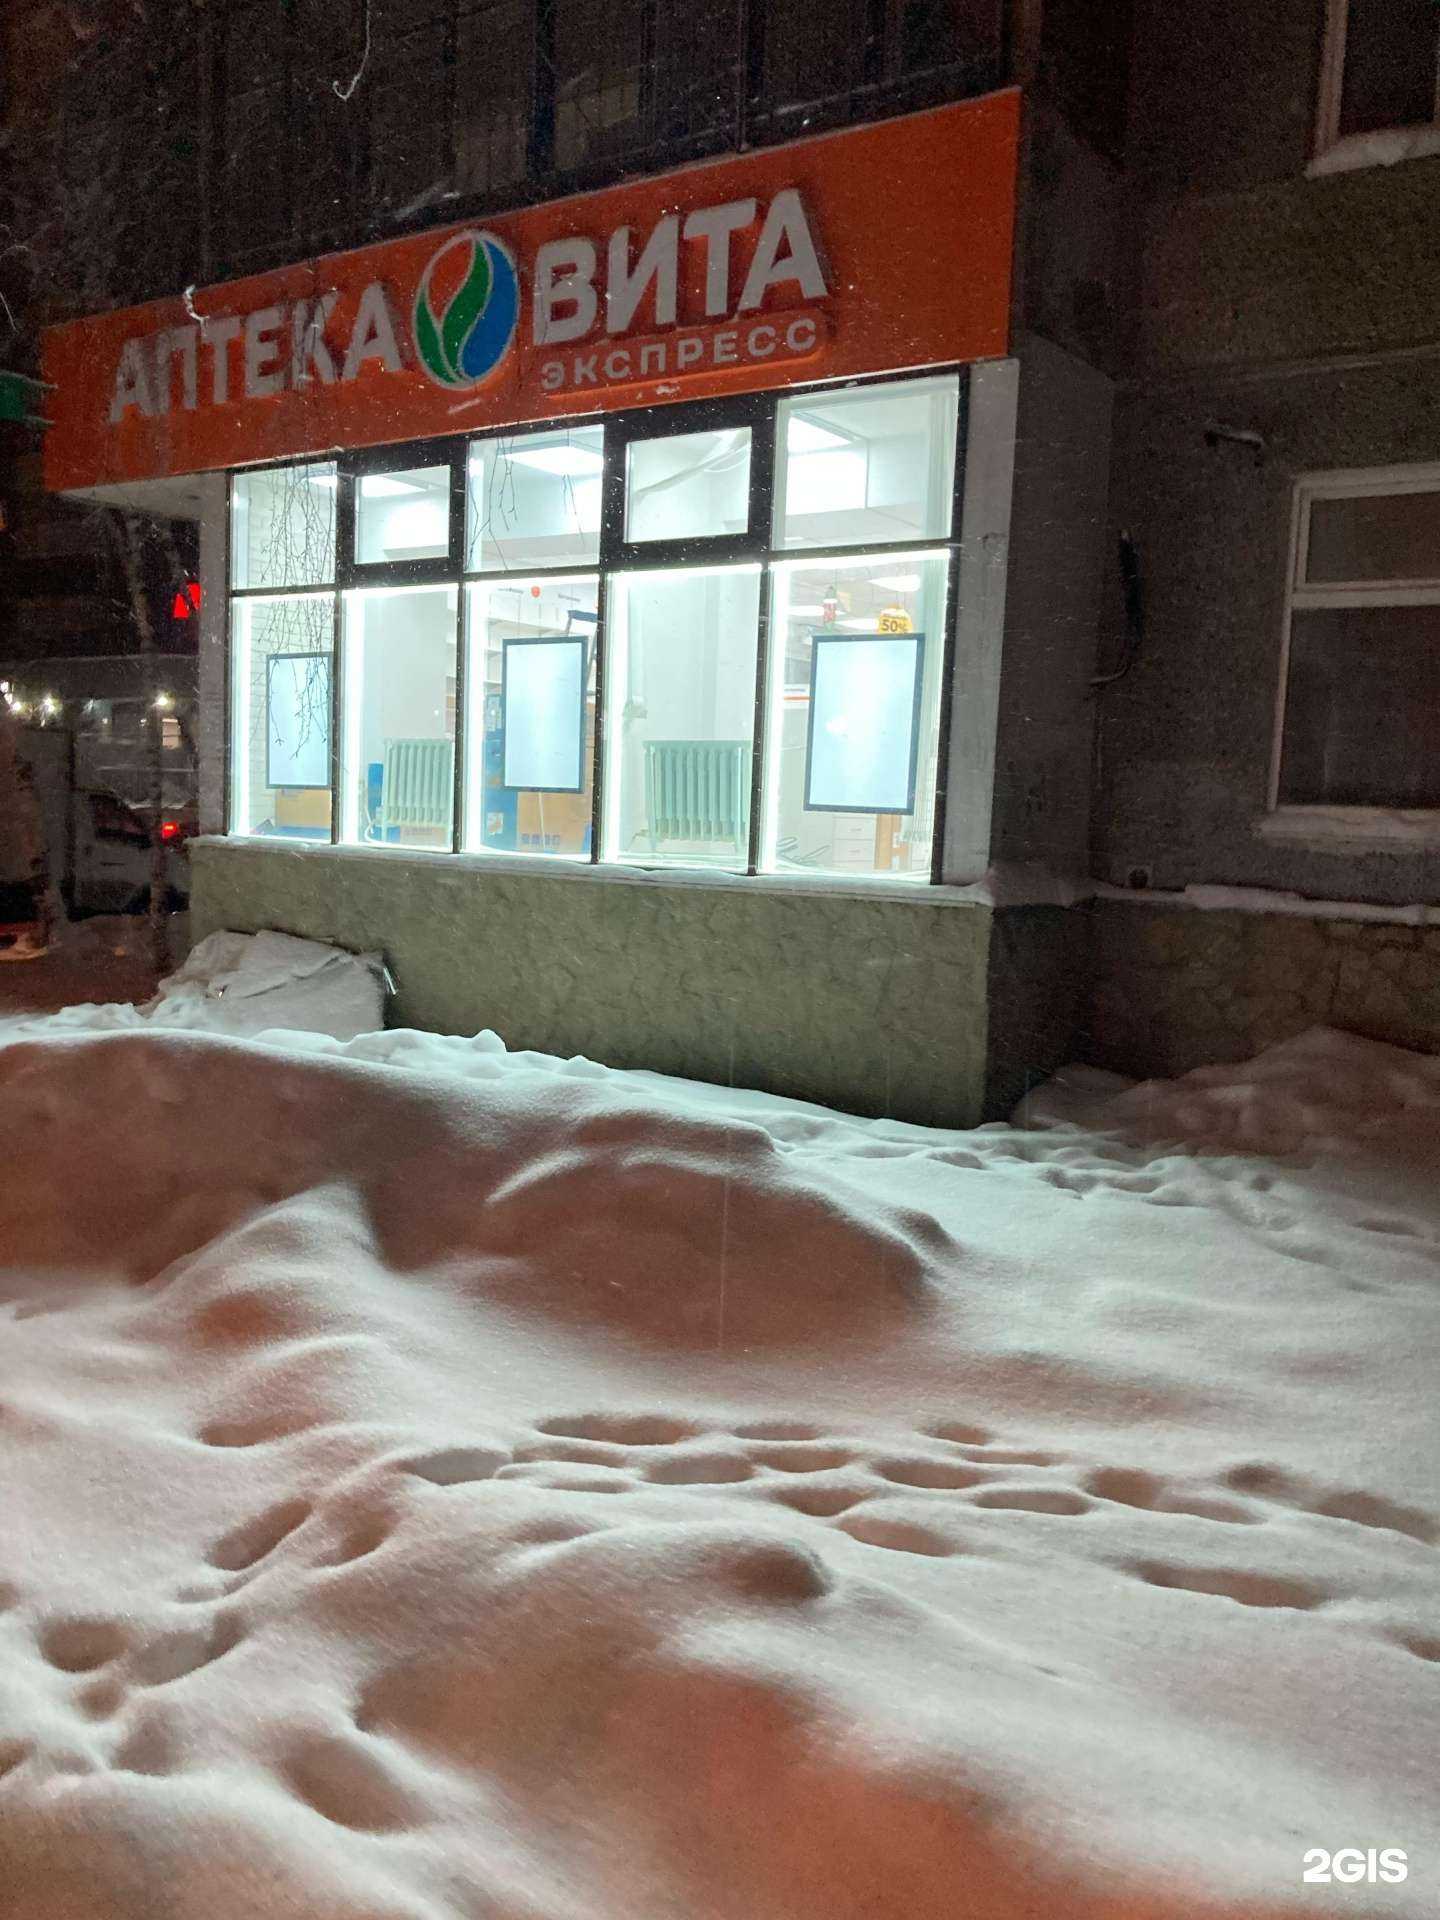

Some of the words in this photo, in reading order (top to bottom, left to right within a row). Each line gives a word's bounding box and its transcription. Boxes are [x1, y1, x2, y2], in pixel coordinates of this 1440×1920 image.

[109, 282, 401, 423] АПТЕКА
[533, 188, 828, 346] ВИТА
[541, 318, 816, 390] ЭКСПРЕСС
